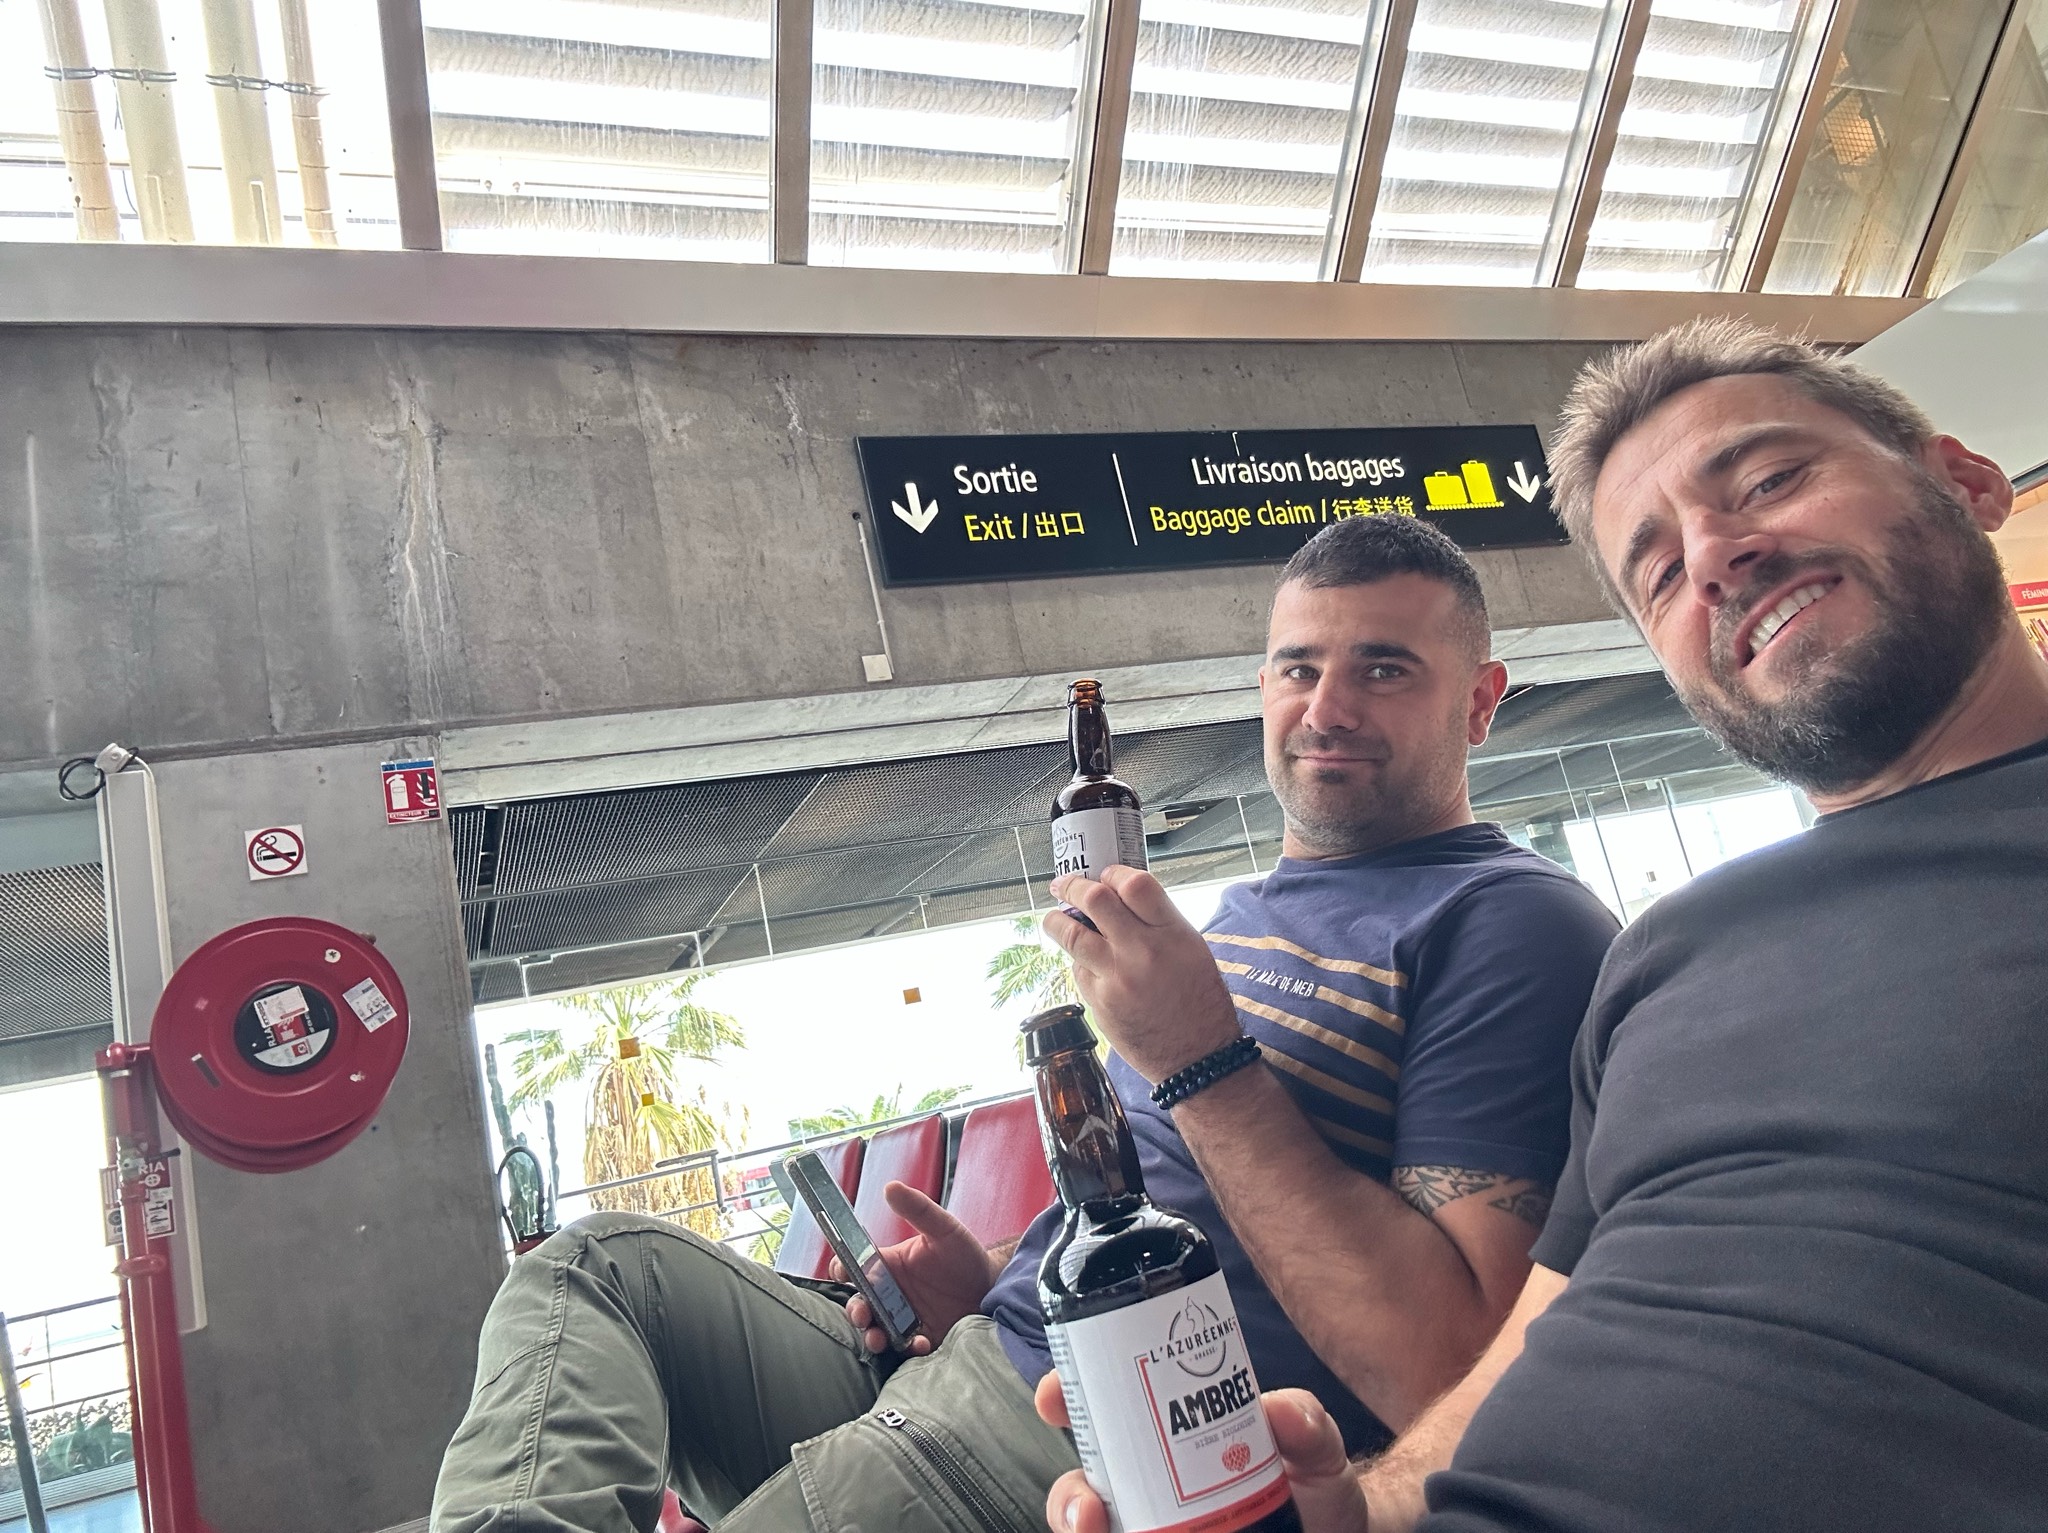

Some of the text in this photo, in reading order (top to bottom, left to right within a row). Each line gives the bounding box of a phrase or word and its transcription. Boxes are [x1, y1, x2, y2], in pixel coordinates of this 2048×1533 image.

[953, 462, 1038, 495] Sortie
[1191, 453, 1405, 487] Livraison bagages
[964, 513, 1016, 542] Exit
[1034, 511, 1085, 538] 出口
[1149, 506, 1252, 537] Baggage
[1256, 499, 1316, 526] claim
[1278, 976, 1294, 990] DE
[139, 1161, 166, 1175] RIA
[1149, 1317, 1234, 1364] L'AZURÉENNE
[1168, 1364, 1256, 1436] AMBRÉE
